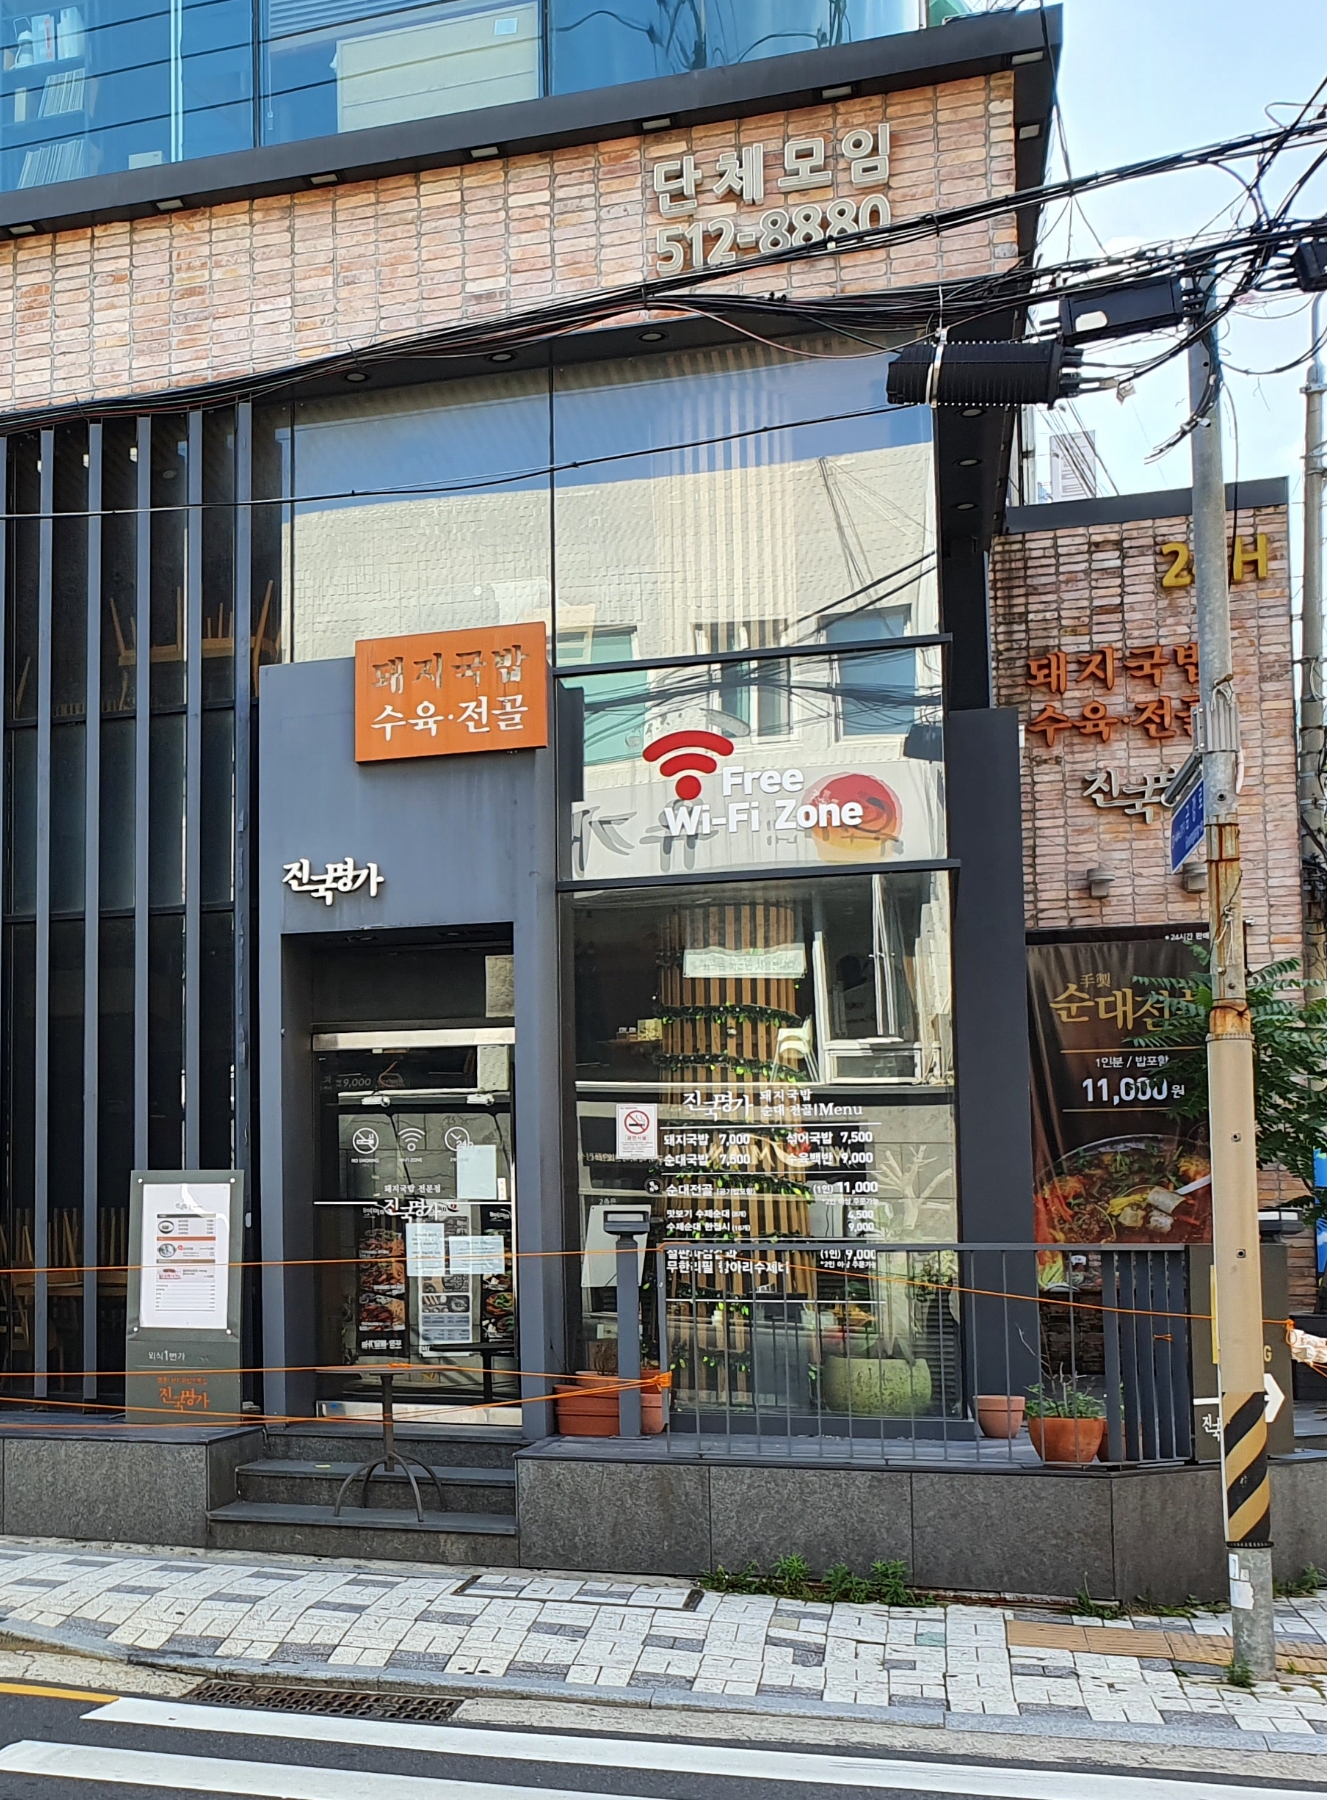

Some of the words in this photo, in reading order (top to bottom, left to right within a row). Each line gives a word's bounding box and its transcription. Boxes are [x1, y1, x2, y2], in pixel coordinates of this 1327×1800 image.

[655, 194, 892, 275] 512-8880
[1161, 533, 1269, 588] 2H
[371, 644, 530, 694] 돼지국밥
[722, 766, 804, 797] Free
[665, 800, 759, 836] Wi-Fi
[775, 800, 863, 830] Zone
[282, 856, 385, 906] 진국명가
[1049, 983, 1199, 1031] 순대전
[1095, 1056, 1123, 1069] 1인분
[759, 1089, 813, 1102] 돼지국밥
[1171, 1084, 1185, 1098] 원
[683, 1089, 754, 1121] 진국명가
[819, 1103, 863, 1116] Menu
[664, 1133, 709, 1146] 돼지국밥
[719, 1134, 750, 1146] 7,000
[840, 1131, 873, 1144] 7,500
[663, 1154, 709, 1166] 순대국밥
[719, 1154, 751, 1166] 7,500
[841, 1152, 873, 1165] 9,000
[384, 1184, 415, 1194] 돼지국밥
[666, 1184, 713, 1196] 순대전골
[837, 1181, 878, 1194] 11,000
[384, 1197, 441, 1223] 진국명가
[666, 1209, 692, 1218] 맛보기
[695, 1209, 730, 1218] 수제순대
[847, 1210, 874, 1219] 4,500
[666, 1222, 701, 1231] 수제순대
[848, 1222, 874, 1232] 9,000
[159, 1386, 210, 1411] 진국명가
